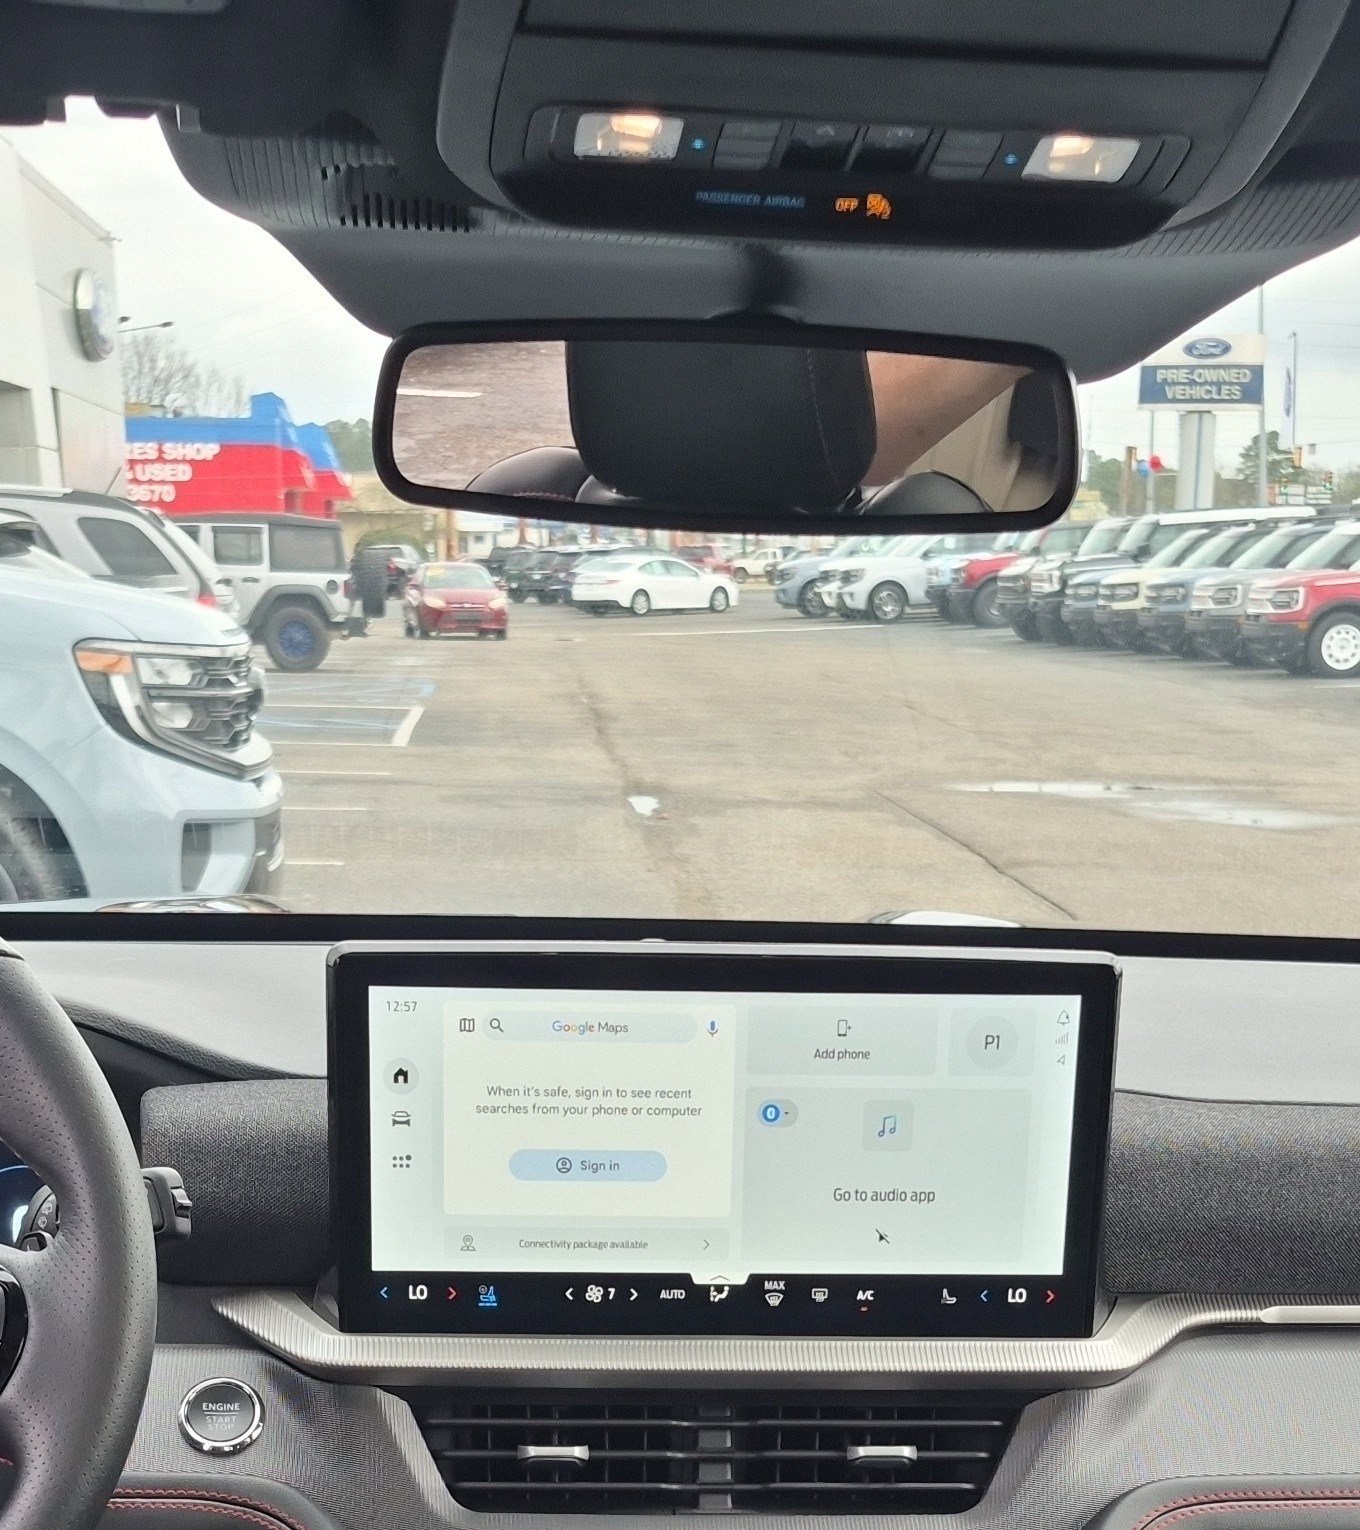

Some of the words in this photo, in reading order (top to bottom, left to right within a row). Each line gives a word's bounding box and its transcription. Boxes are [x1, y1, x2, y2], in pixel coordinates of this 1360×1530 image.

[695, 191, 761, 206] PASSENGER
[763, 194, 806, 209] AIRBAG
[835, 197, 859, 212] OFF
[1156, 368, 1252, 383] PRE-OWNED
[1165, 385, 1242, 400] VEHICLES
[161, 443, 221, 461] SHOP
[134, 463, 193, 482] USED
[386, 1000, 418, 1013] 12:57
[552, 1020, 595, 1035] Google
[597, 1021, 629, 1035] Maps
[984, 1034, 1001, 1050] P1
[814, 1048, 835, 1060] Add
[837, 1049, 871, 1061] phone
[487, 1086, 520, 1097] When
[543, 1086, 572, 1098] safe,
[575, 1087, 599, 1100] sign
[602, 1087, 613, 1098] in
[616, 1088, 628, 1098] to
[631, 1090, 652, 1099] see
[655, 1088, 692, 1099] recent
[476, 1103, 529, 1114] searches
[532, 1103, 560, 1115] from
[563, 1105, 588, 1117] your
[592, 1104, 628, 1117] phone
[631, 1106, 643, 1116] or
[646, 1106, 703, 1119] computer
[580, 1159, 606, 1174] Sign
[609, 1159, 620, 1172] in
[833, 1187, 851, 1202] Go
[854, 1188, 868, 1202] to
[870, 1188, 908, 1202] audio
[910, 1190, 936, 1205] app
[519, 1239, 572, 1250] Connectivity
[573, 1240, 608, 1251] package
[609, 1240, 649, 1250] available
[764, 1280, 786, 1291] MAX
[408, 1284, 428, 1300] LO
[607, 1287, 616, 1300] 7
[660, 1289, 686, 1300] AUTO
[856, 1289, 876, 1301] A/C
[1006, 1287, 1027, 1304] LO
[202, 1402, 241, 1411] ENGINE
